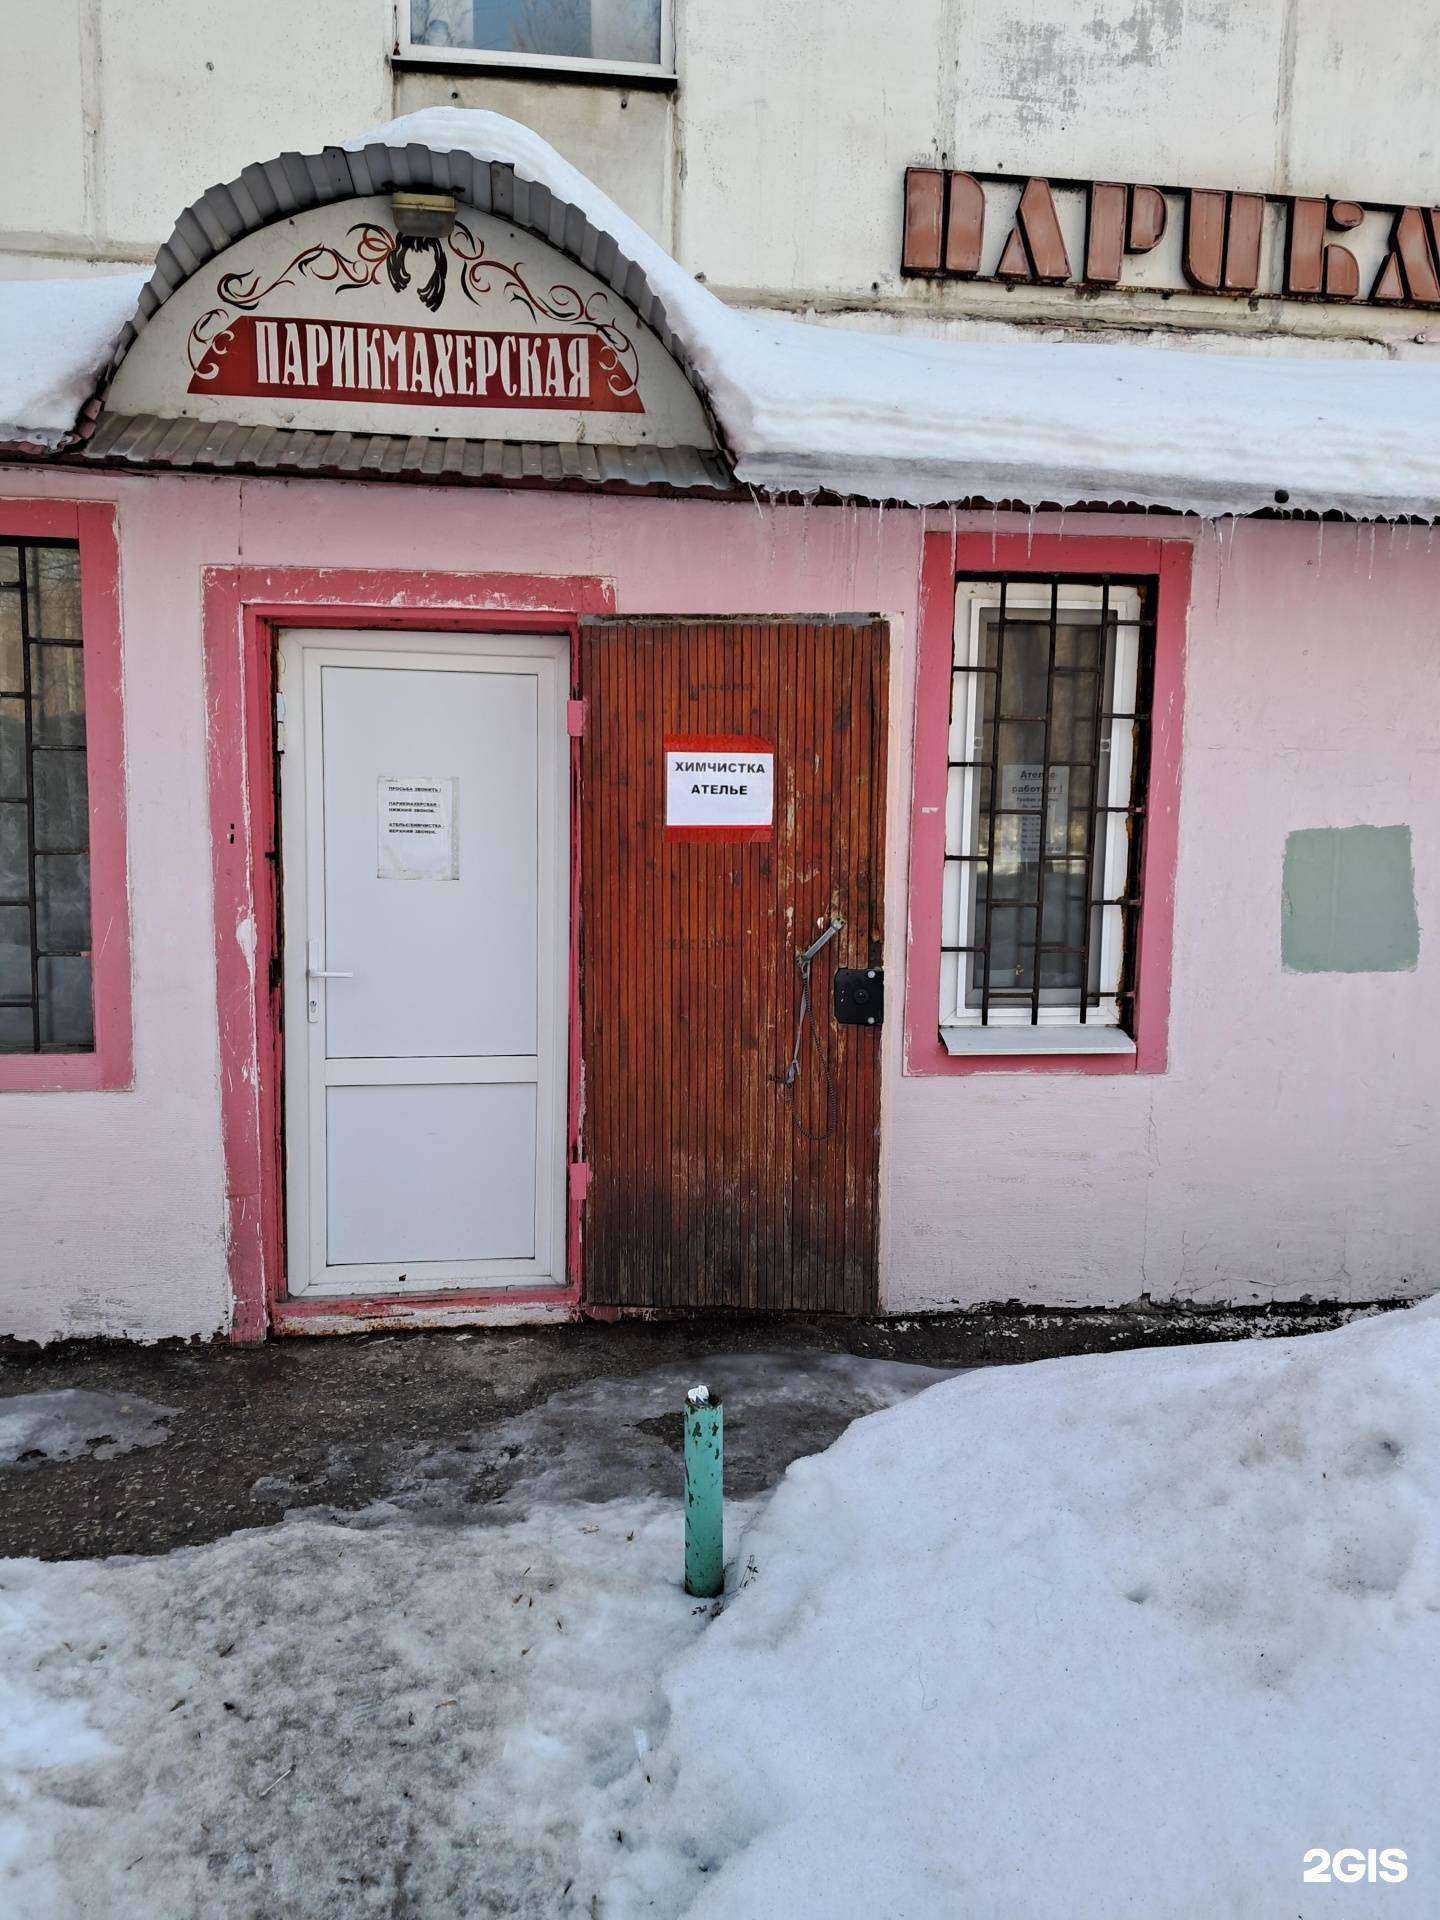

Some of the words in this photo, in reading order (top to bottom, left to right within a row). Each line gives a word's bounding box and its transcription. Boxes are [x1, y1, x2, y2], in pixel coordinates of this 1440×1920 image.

[255, 321, 591, 398] ПАРИКМАХЕРСКАЯ
[675, 762, 765, 773] ХИМЧИСТКА
[1020, 770, 1056, 778] Ателе
[691, 784, 748, 795] АТЕЛЬЕ
[1012, 785, 1057, 794] работет
